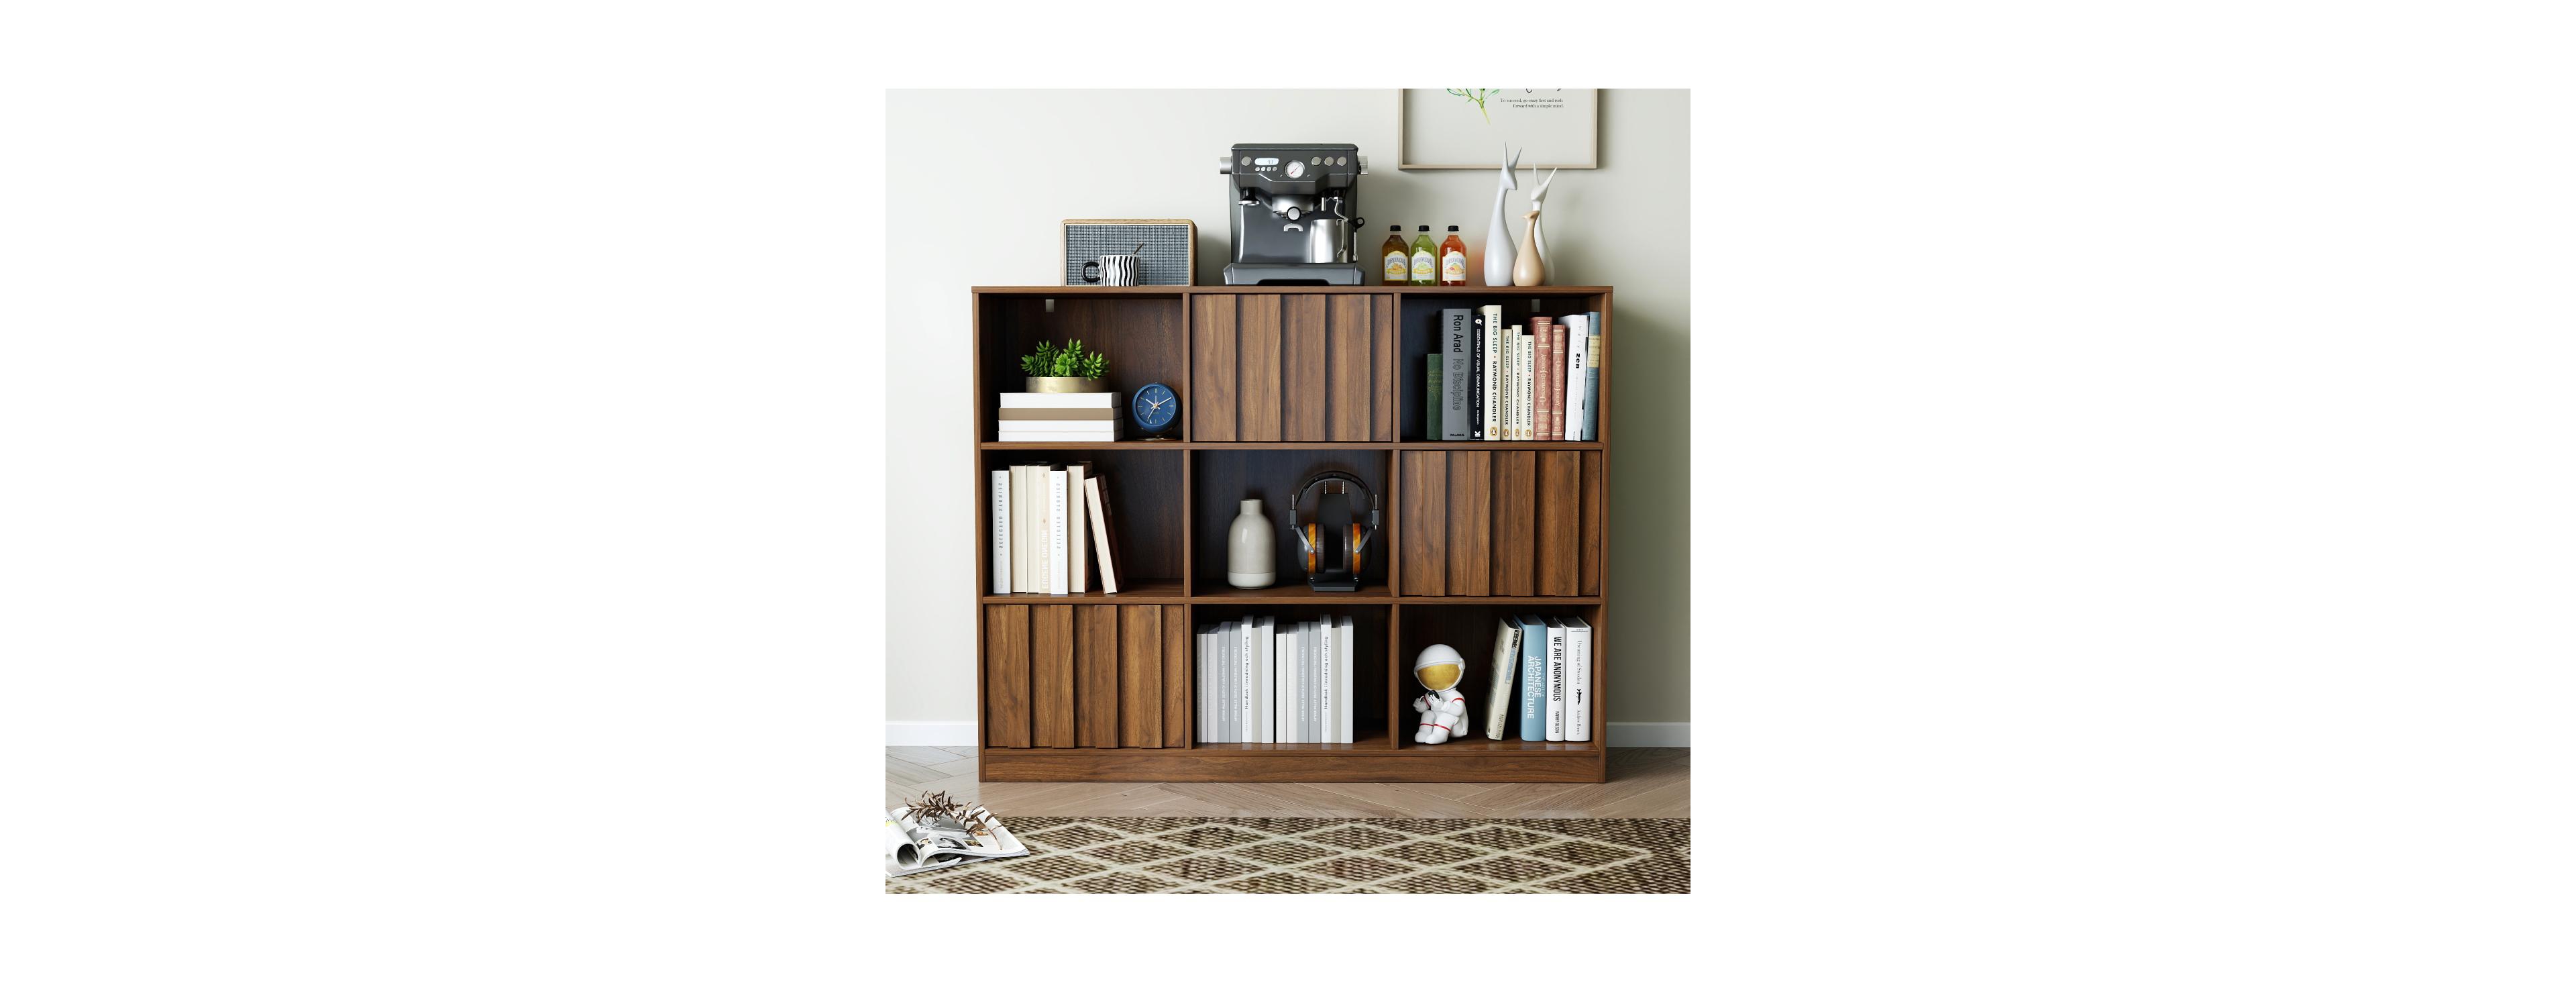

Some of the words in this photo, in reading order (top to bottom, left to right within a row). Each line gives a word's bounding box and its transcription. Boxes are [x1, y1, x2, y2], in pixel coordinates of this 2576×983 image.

[1453, 315, 1464, 331] Ron
[1453, 333, 1464, 353] Arad
[1453, 359, 1464, 370] No
[1451, 372, 1464, 410] Discipline
[1554, 637, 1562, 646] WE
[1553, 662, 1561, 701] ANONYMOUS
